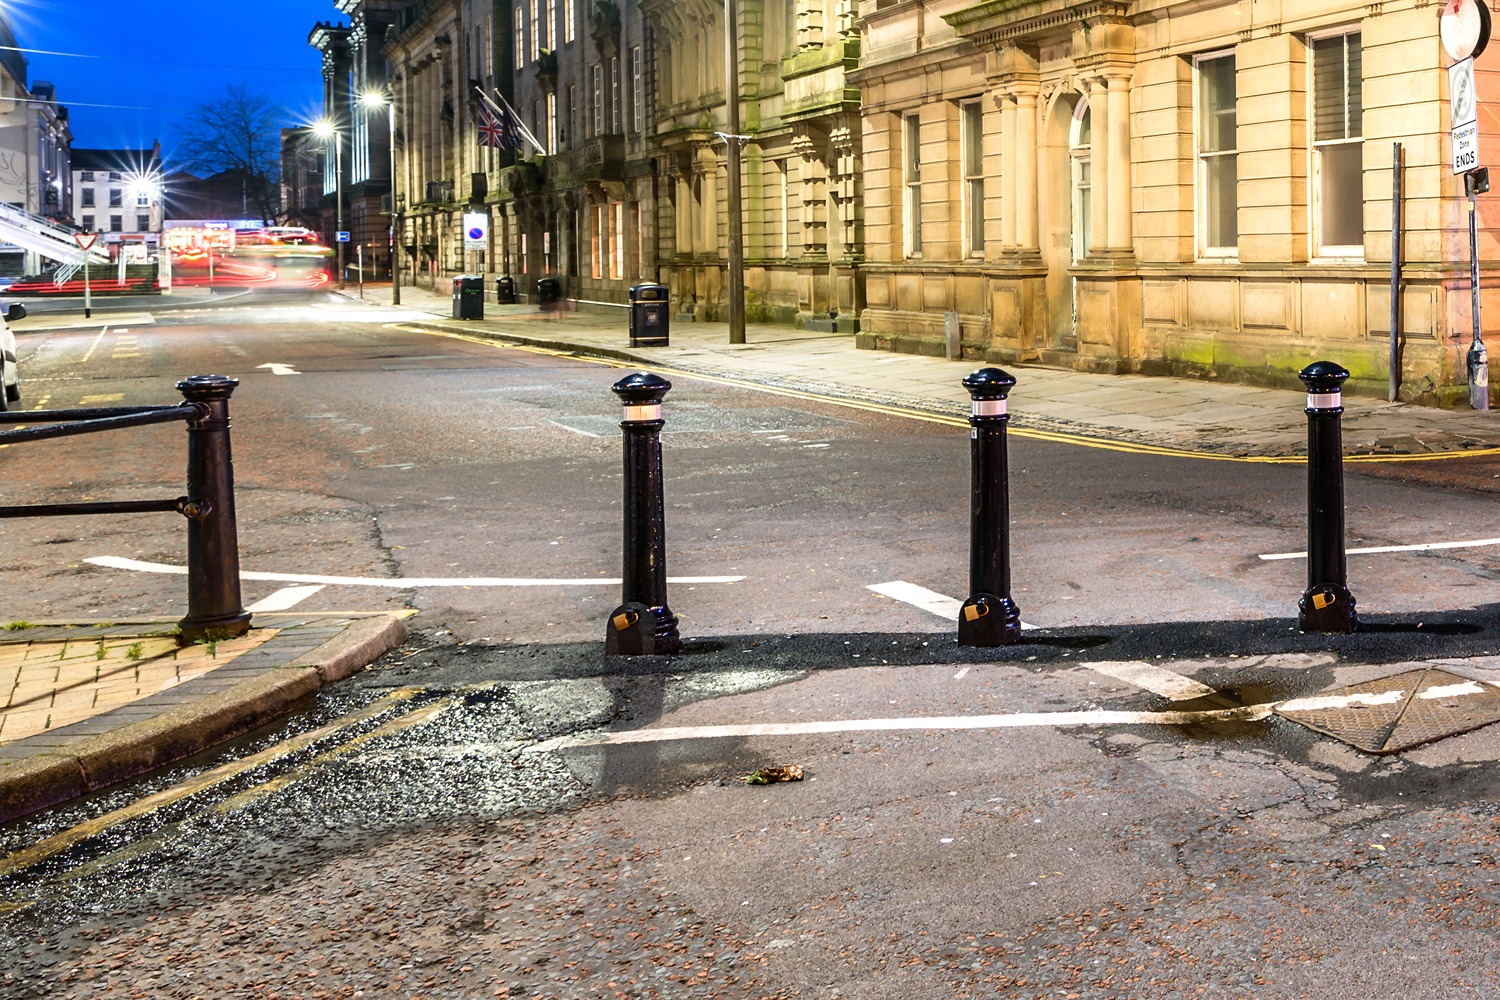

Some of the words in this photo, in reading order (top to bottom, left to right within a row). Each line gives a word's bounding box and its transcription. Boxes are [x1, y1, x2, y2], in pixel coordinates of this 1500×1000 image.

[1453, 127, 1476, 141] Pedestrian
[1459, 140, 1470, 150] Zone
[1456, 150, 1475, 168] ENDS
